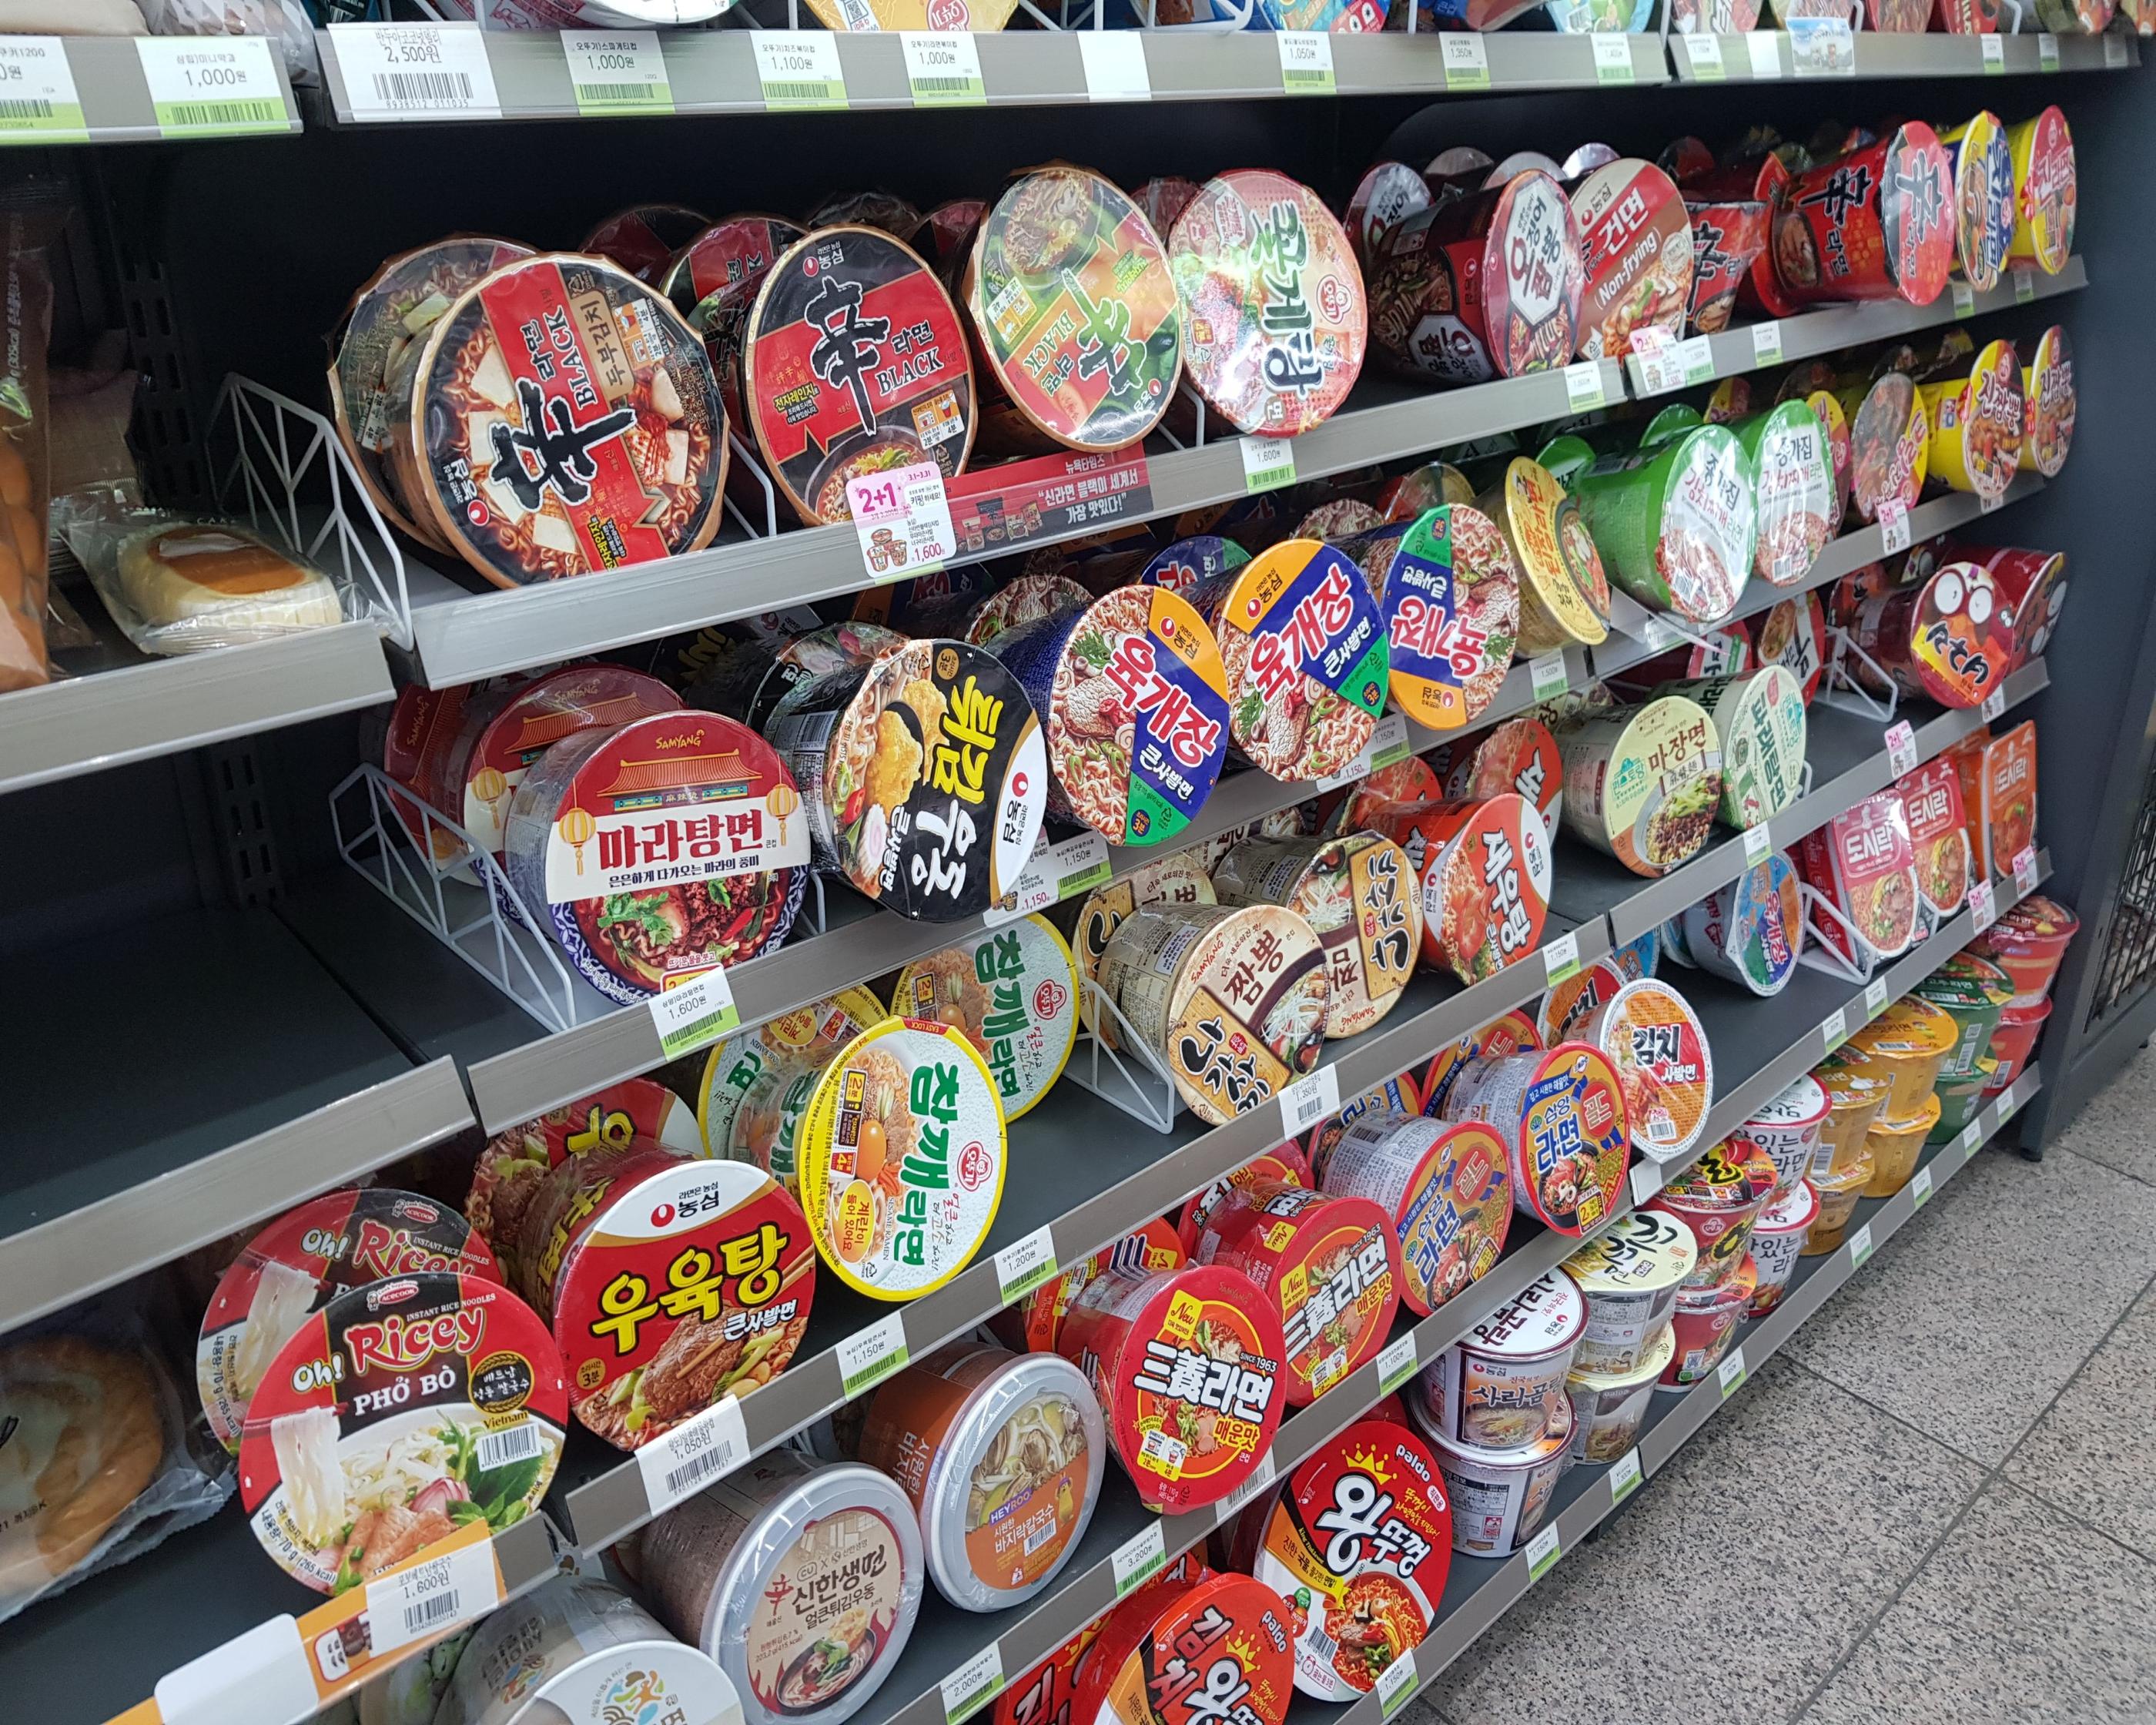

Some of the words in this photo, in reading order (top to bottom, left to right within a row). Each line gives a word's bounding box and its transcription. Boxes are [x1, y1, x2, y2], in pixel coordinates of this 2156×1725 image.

[384, 45, 443, 64] 2,500원
[576, 42, 638, 52] 오뚜기)스파게티컵
[586, 55, 635, 70] 1,000원
[771, 56, 814, 72] 1,100원
[919, 52, 956, 65] 1,000원
[1289, 47, 1317, 60] 1,050원
[185, 68, 247, 87] 1,000원
[1895, 149, 1944, 245] 辛
[1598, 186, 1647, 258] 건면
[818, 250, 845, 270] 농심
[1593, 226, 1662, 310] (Non-frying)
[1825, 228, 1850, 276] 라면
[1905, 223, 1918, 279] 라면
[1320, 282, 1340, 320] 오뚜기
[520, 318, 554, 380] 라면
[580, 299, 624, 387] 두부김치
[891, 319, 934, 355] 라면
[1021, 310, 1076, 374] BLACK
[1060, 268, 1147, 397] 辛
[552, 305, 601, 409] BLACK
[804, 274, 891, 437] 辛
[875, 346, 945, 397] BLACK
[1040, 349, 1075, 397] 라면
[773, 382, 820, 413] 전자레인지로
[1977, 370, 2021, 430] 진짬뽕
[2039, 360, 2073, 413] 진짬뽕
[487, 377, 638, 514] 辛
[946, 424, 957, 434] 4분
[1065, 453, 1106, 474] 뉴욕타임즈
[1256, 450, 1281, 464] 1,600원
[1776, 433, 1813, 467] 종가집
[450, 458, 477, 502] 농심
[857, 481, 898, 514] 2+1
[1038, 484, 1075, 507] “신라면
[1076, 476, 1108, 498] 블랙이
[1110, 468, 1140, 488] 세계서
[909, 492, 925, 507] 키핑
[924, 491, 941, 504] 하세요!
[1065, 504, 1087, 524] 가장
[1090, 494, 1129, 518] 맛있다!”
[1260, 573, 1284, 607] 농심
[1400, 564, 1448, 601] 큰사발면
[1172, 631, 1198, 662] 농심
[1249, 562, 1354, 705] 육개장
[1322, 615, 1371, 681] 큰사발면
[1390, 597, 1491, 683] 육개장
[939, 651, 953, 670] 3분
[1101, 633, 1223, 769] 육개장
[1364, 688, 1381, 706] 3분
[655, 733, 702, 750] SAMYANG
[932, 675, 1004, 805] 튀김
[1374, 729, 1396, 745] 1,150원
[1648, 717, 1706, 772] 마장면
[1751, 692, 1787, 813] 파래탕면
[1140, 742, 1195, 809] 큰사발면
[1995, 759, 2027, 795] 도시락
[1003, 800, 1023, 846] 농심
[1132, 817, 1147, 832] 3분
[1908, 793, 1949, 828] 도시락
[596, 808, 764, 871] 마라탕면
[765, 839, 777, 849] 큰컵
[878, 805, 912, 894] 큰사발면
[910, 799, 978, 900] 우동
[1846, 828, 1893, 865] 도시락
[608, 869, 655, 889] 은은하게
[656, 863, 702, 883] 다가오는
[704, 859, 737, 876] 마라의
[738, 853, 760, 871] 풍미
[1063, 850, 1092, 867] 1,150원
[1482, 828, 1532, 949] 새우탕
[1369, 848, 1411, 973] 나가사끼
[1764, 890, 1788, 965] 육개장
[667, 955, 689, 969] 뜨거운
[688, 953, 701, 966] 물을
[701, 951, 716, 963] 붓고
[1223, 929, 1285, 1007] 짬뽕
[661, 983, 705, 1009] 삼양)마라탕면컵
[668, 993, 708, 1020] 1,600원
[973, 929, 1029, 1099] 참깨라면
[1035, 982, 1050, 1018] 오뚜기
[1630, 1025, 1681, 1067] 김치
[849, 1074, 863, 1100] 2분
[1660, 1063, 1698, 1082] 사발면
[1544, 1095, 1572, 1125] 삼양
[1583, 1089, 1612, 1130] 골드
[1535, 1113, 1582, 1174] 라면
[834, 1154, 847, 1174] 4분
[892, 1061, 959, 1267] 참깨라면
[959, 1144, 979, 1187] 오뚜기
[1456, 1151, 1489, 1200] 골드
[676, 1191, 720, 1220] 농심
[678, 1189, 701, 1202] 라면은
[702, 1181, 719, 1194] 농심
[845, 1191, 860, 1217] 들어
[856, 1200, 873, 1245] 계란이
[888, 1196, 897, 1227] SESAME
[942, 1193, 960, 1245] 얼큰하고
[1418, 1193, 1445, 1241] 삼양
[301, 1228, 350, 1260] Oh!
[413, 1236, 442, 1253] INSTANT
[442, 1245, 460, 1256] RICE
[460, 1250, 490, 1266] NOODLES
[842, 1218, 856, 1253] 있어요
[882, 1230, 892, 1261] RAMEN
[1348, 1240, 1363, 1254] SINCE
[1362, 1222, 1382, 1243] 1963
[1414, 1198, 1461, 1288] 라면
[1007, 1252, 1037, 1272] 1,200원
[381, 1287, 417, 1303] ACECOOK
[590, 1224, 788, 1355] 우육탕
[1283, 1272, 1305, 1299] New
[1355, 1272, 1392, 1317] 매운맛
[407, 1306, 439, 1322] INSTANT
[440, 1301, 460, 1313] RICE
[460, 1293, 497, 1308] NOODLES
[722, 1298, 797, 1343] 큰사발면
[1170, 1301, 1194, 1326] New
[343, 1307, 487, 1376] Ricey
[852, 1341, 886, 1366] 1,150원
[292, 1354, 345, 1394] Oh!
[483, 1365, 517, 1384] 베트남
[1239, 1352, 1257, 1363] SINCE
[1255, 1356, 1278, 1373] 1963
[1384, 1351, 1405, 1369] 1,100원
[1485, 1366, 1507, 1378] 농심
[472, 1385, 494, 1401] 정통
[496, 1377, 531, 1395] 쌀국수
[582, 1372, 599, 1387] 3분
[1133, 1339, 1275, 1424] 三養라면
[1471, 1372, 1566, 1408] 사리곰탕
[482, 1410, 529, 1430] Vietnam
[1213, 1417, 1260, 1453] 매운맛
[672, 1432, 711, 1461] 1,050원
[1238, 1451, 1251, 1464] 큰컵
[1395, 1444, 1431, 1483] paldo
[906, 1442, 929, 1497] 시원한
[989, 1491, 1030, 1524] HEYROO
[1404, 1487, 1432, 1513] 뚜껑이
[994, 1517, 1015, 1538] 시원한
[994, 1502, 1056, 1554] 바지락칼국수
[1314, 1471, 1433, 1579] 왕뚜껑
[1127, 1543, 1154, 1568] 3,200원
[403, 1570, 450, 1601] 1,600원
[764, 1573, 795, 1616] 辛
[791, 1543, 888, 1616] 신한생면
[805, 1581, 877, 1631] 얼큰튀김우동
[1260, 1609, 1287, 1653] paldo
[1147, 1603, 1234, 1711] 김치
[952, 1668, 985, 1698] 2,000원
[1384, 1676, 1408, 1695] 1,150원
